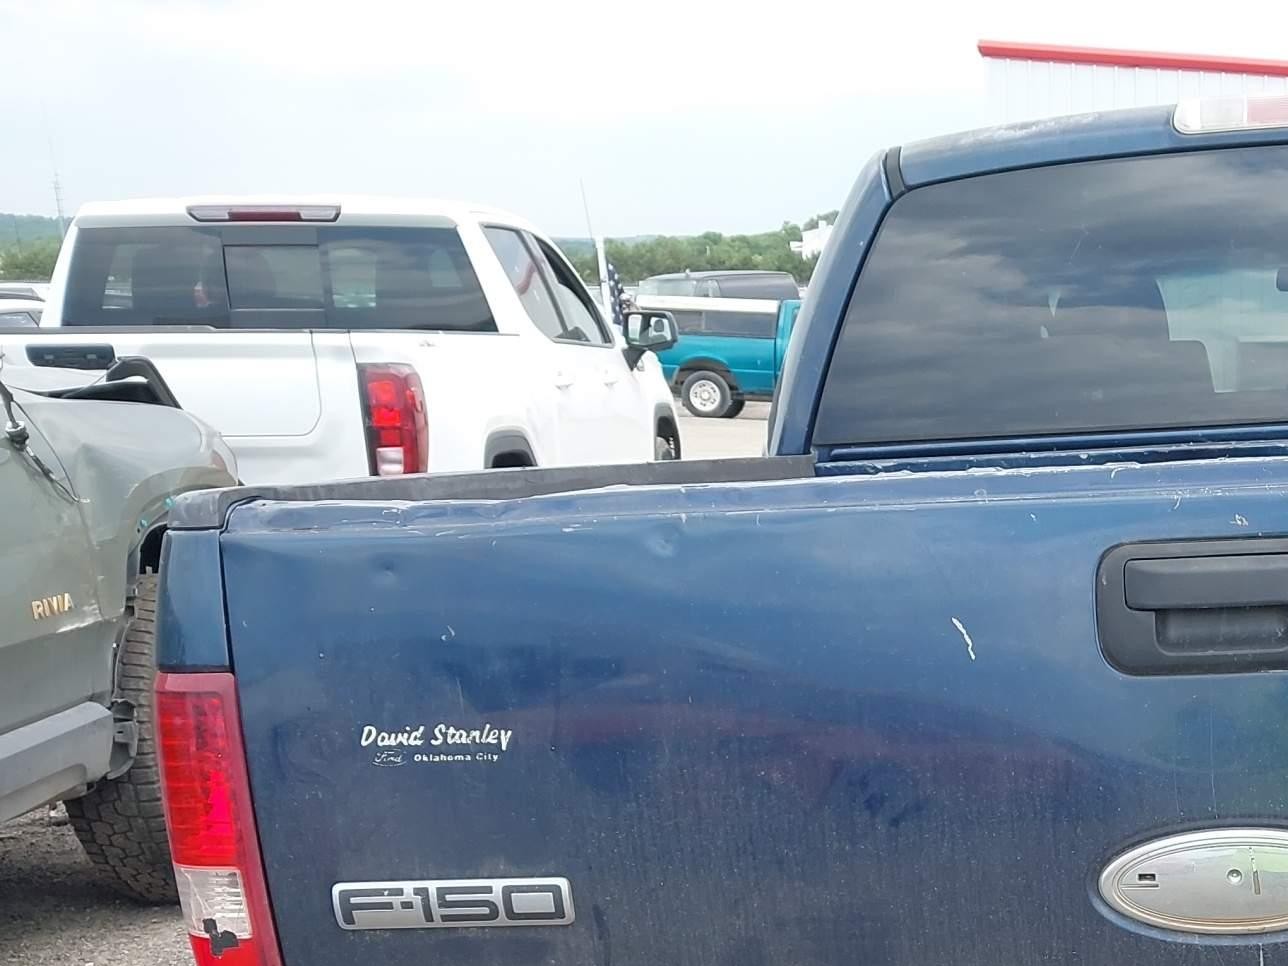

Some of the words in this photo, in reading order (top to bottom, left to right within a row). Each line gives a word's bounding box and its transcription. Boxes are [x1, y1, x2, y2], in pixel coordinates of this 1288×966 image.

[361, 726, 425, 747] David
[430, 724, 513, 751] Stanley
[413, 753, 472, 762] Oklahoma
[475, 751, 499, 762] City
[338, 885, 568, 926] F-150
